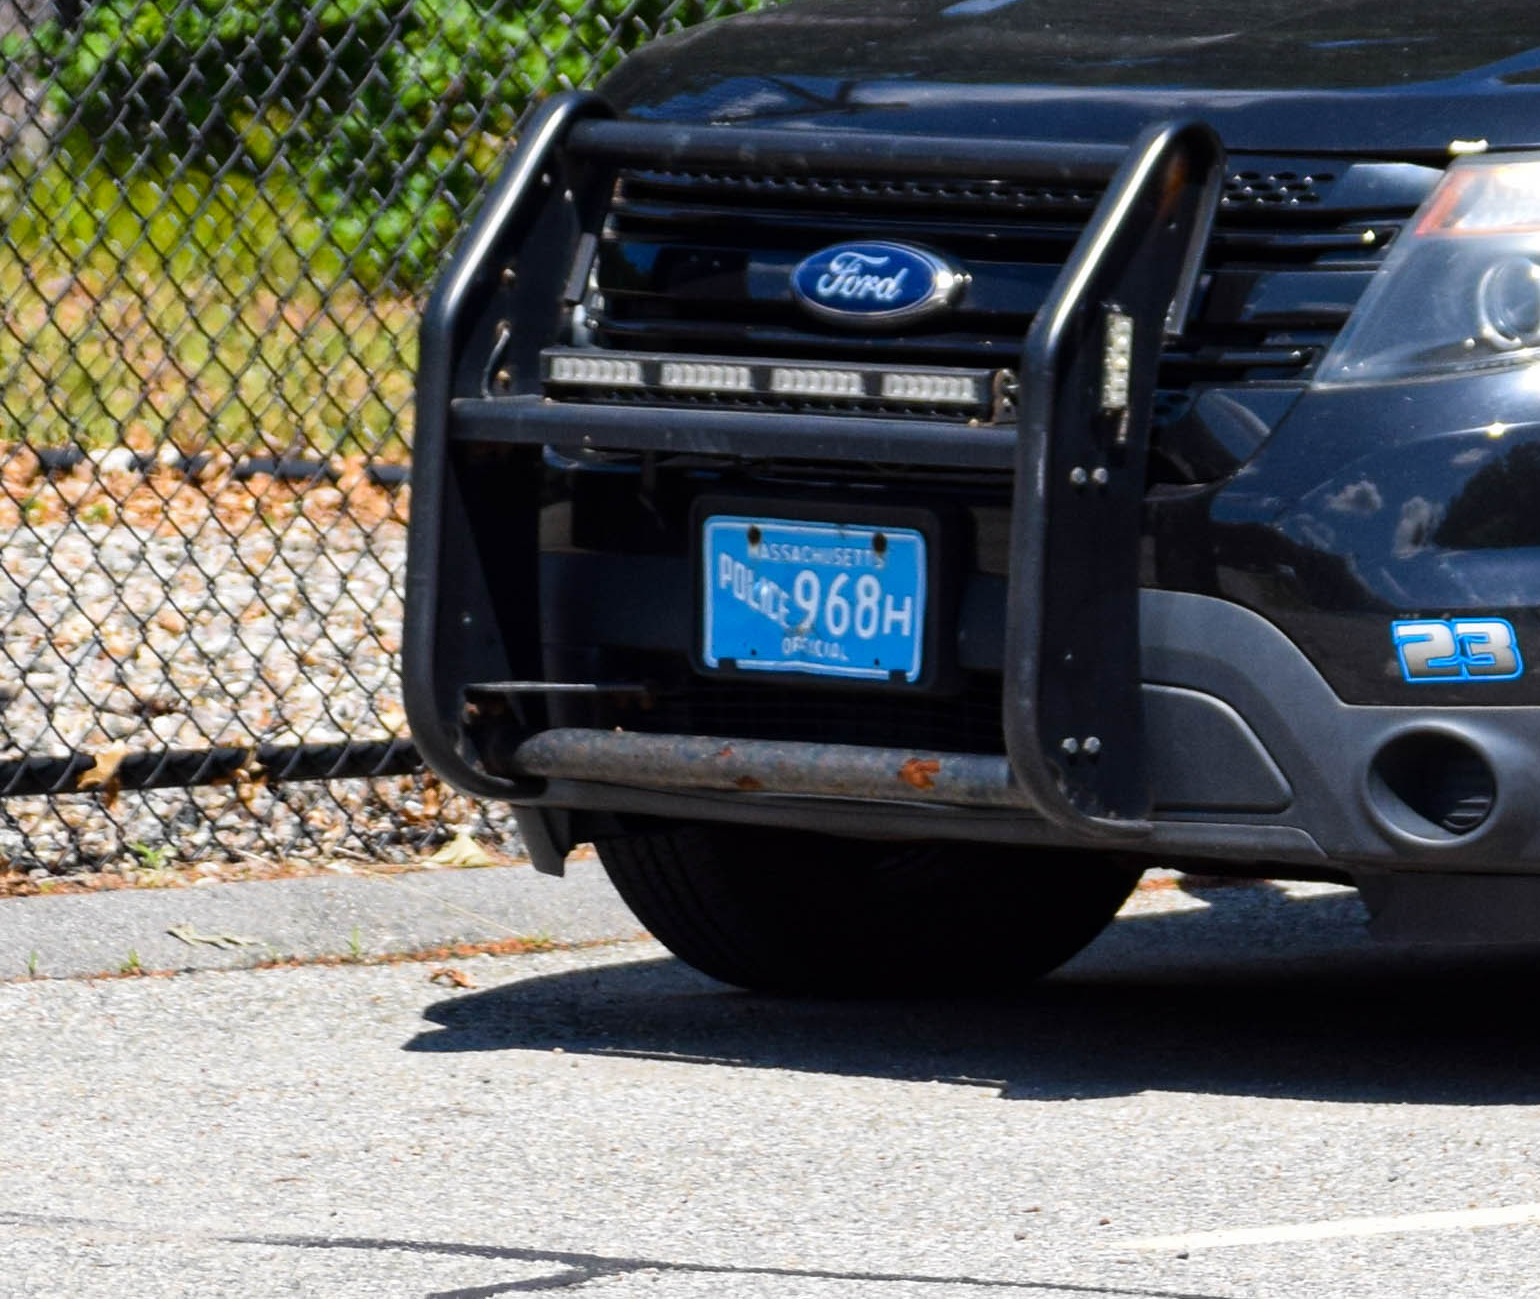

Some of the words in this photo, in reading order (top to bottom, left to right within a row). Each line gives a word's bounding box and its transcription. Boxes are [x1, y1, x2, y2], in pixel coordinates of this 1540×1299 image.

[816, 251, 909, 301] Ford
[748, 543, 885, 570] MASSACHUSETTS
[718, 552, 792, 630] POLICE
[793, 569, 912, 639] 968H
[781, 637, 849, 662] OFFICIAL
[1391, 618, 1524, 682] 23
